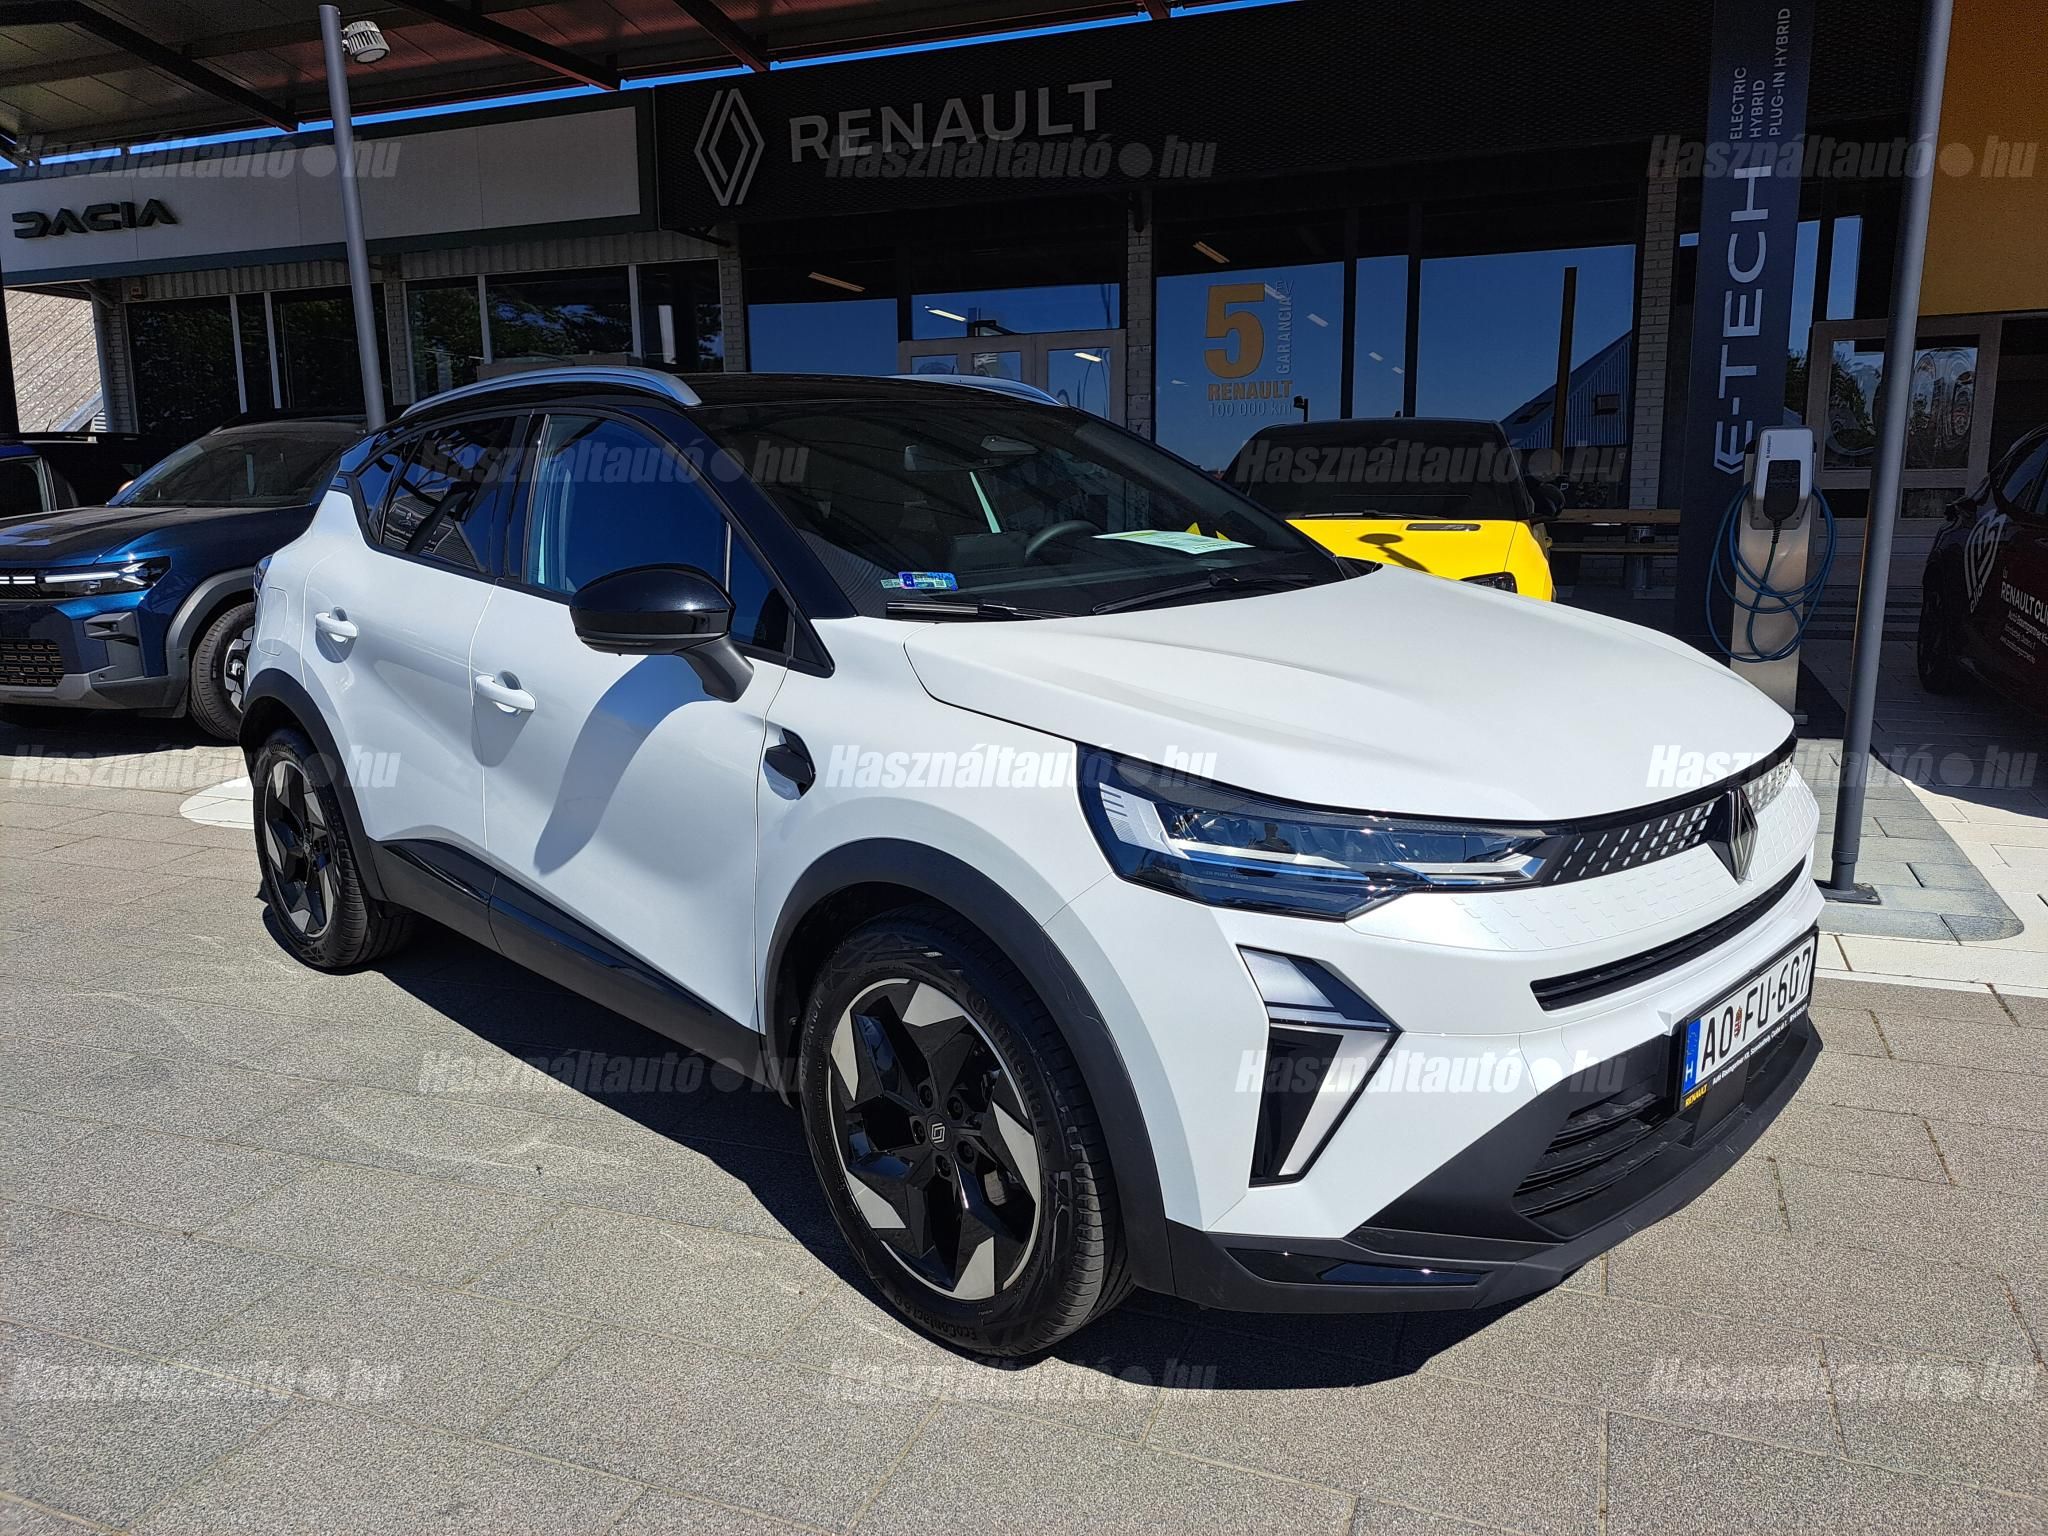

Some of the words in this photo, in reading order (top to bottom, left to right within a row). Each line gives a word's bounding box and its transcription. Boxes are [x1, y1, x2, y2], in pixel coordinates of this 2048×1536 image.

[1774, 7, 1791, 67] HYBRID
[790, 79, 1113, 163] RENAULT
[1730, 67, 1747, 140] ELECTRIC
[1750, 79, 1766, 138] HYBRID
[1768, 71, 1786, 136] PLUG-IN
[12, 198, 178, 239] DACIA
[1204, 282, 1266, 379] 5
[1275, 296, 1293, 375] GARANCIA
[1208, 380, 1293, 401] RENAULT
[1209, 402, 1235, 417] 100
[1239, 401, 1266, 417] 000
[2001, 581, 2035, 616] RENAULT
[1702, 1005, 1734, 1073] AO
[1742, 946, 1812, 1042] FU-607
[1684, 1060, 1694, 1083] H
[1684, 1084, 1708, 1108] RENAULT
